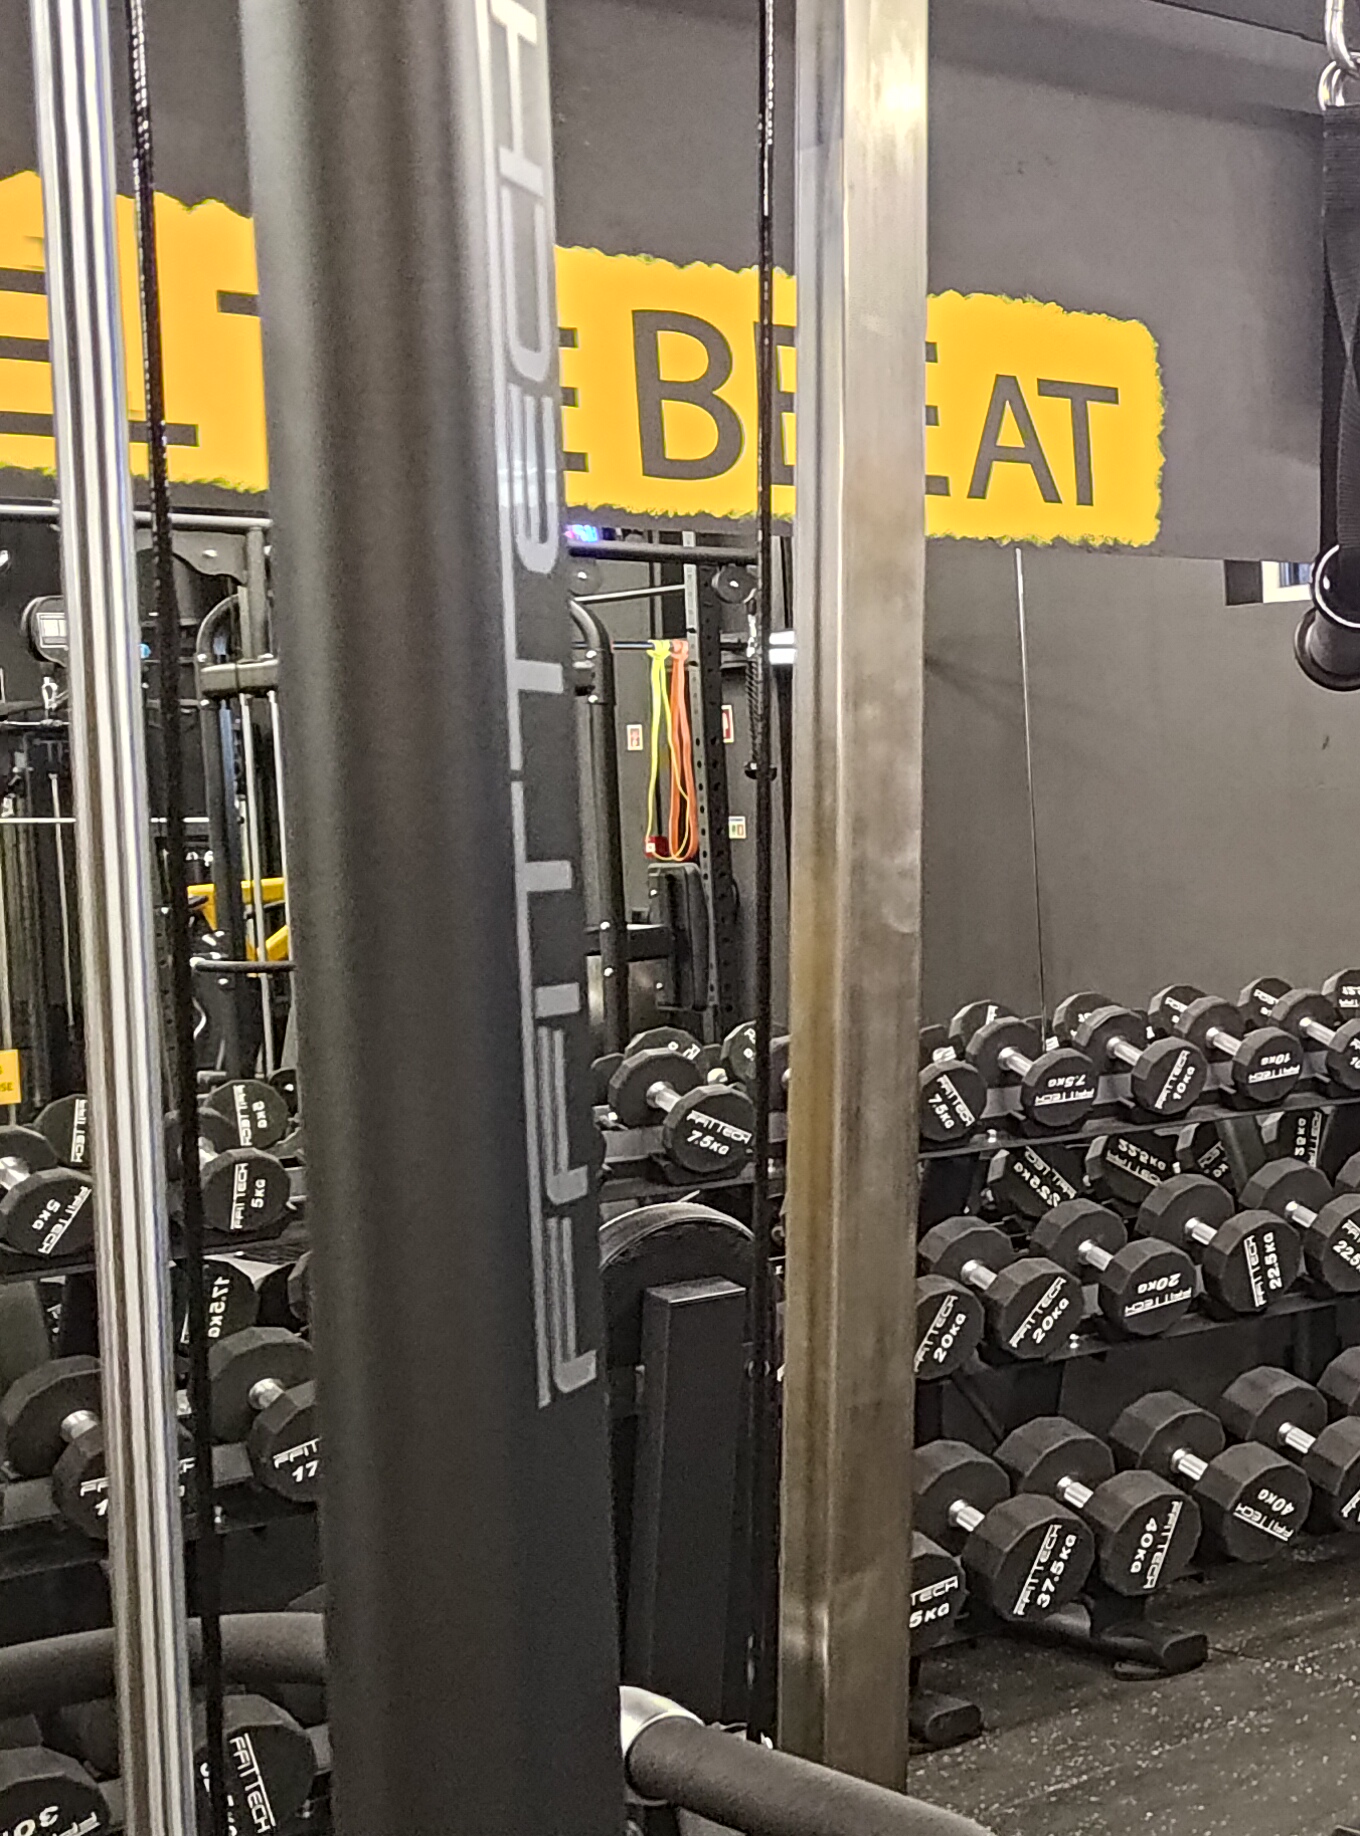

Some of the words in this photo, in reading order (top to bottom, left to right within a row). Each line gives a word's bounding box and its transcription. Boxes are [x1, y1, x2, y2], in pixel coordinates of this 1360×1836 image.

[1261, 1053, 1291, 1066] 10KG
[1048, 1075, 1086, 1087] 7.5KG
[1173, 1066, 1196, 1100] 10KG
[928, 1093, 955, 1129] 7.5KG
[687, 1130, 730, 1155] 7.5KG
[251, 1179, 266, 1208] 5KG
[31, 1199, 61, 1230] 5KG
[1263, 1231, 1282, 1290] 22.5KG
[1137, 1273, 1181, 1294] 20KG
[1032, 1297, 1069, 1344] 20KG
[933, 1313, 966, 1363] 20KG
[1258, 1489, 1295, 1516] 40KG
[1130, 1518, 1158, 1574] 40KG
[1036, 1534, 1077, 1608] 37.5KG
